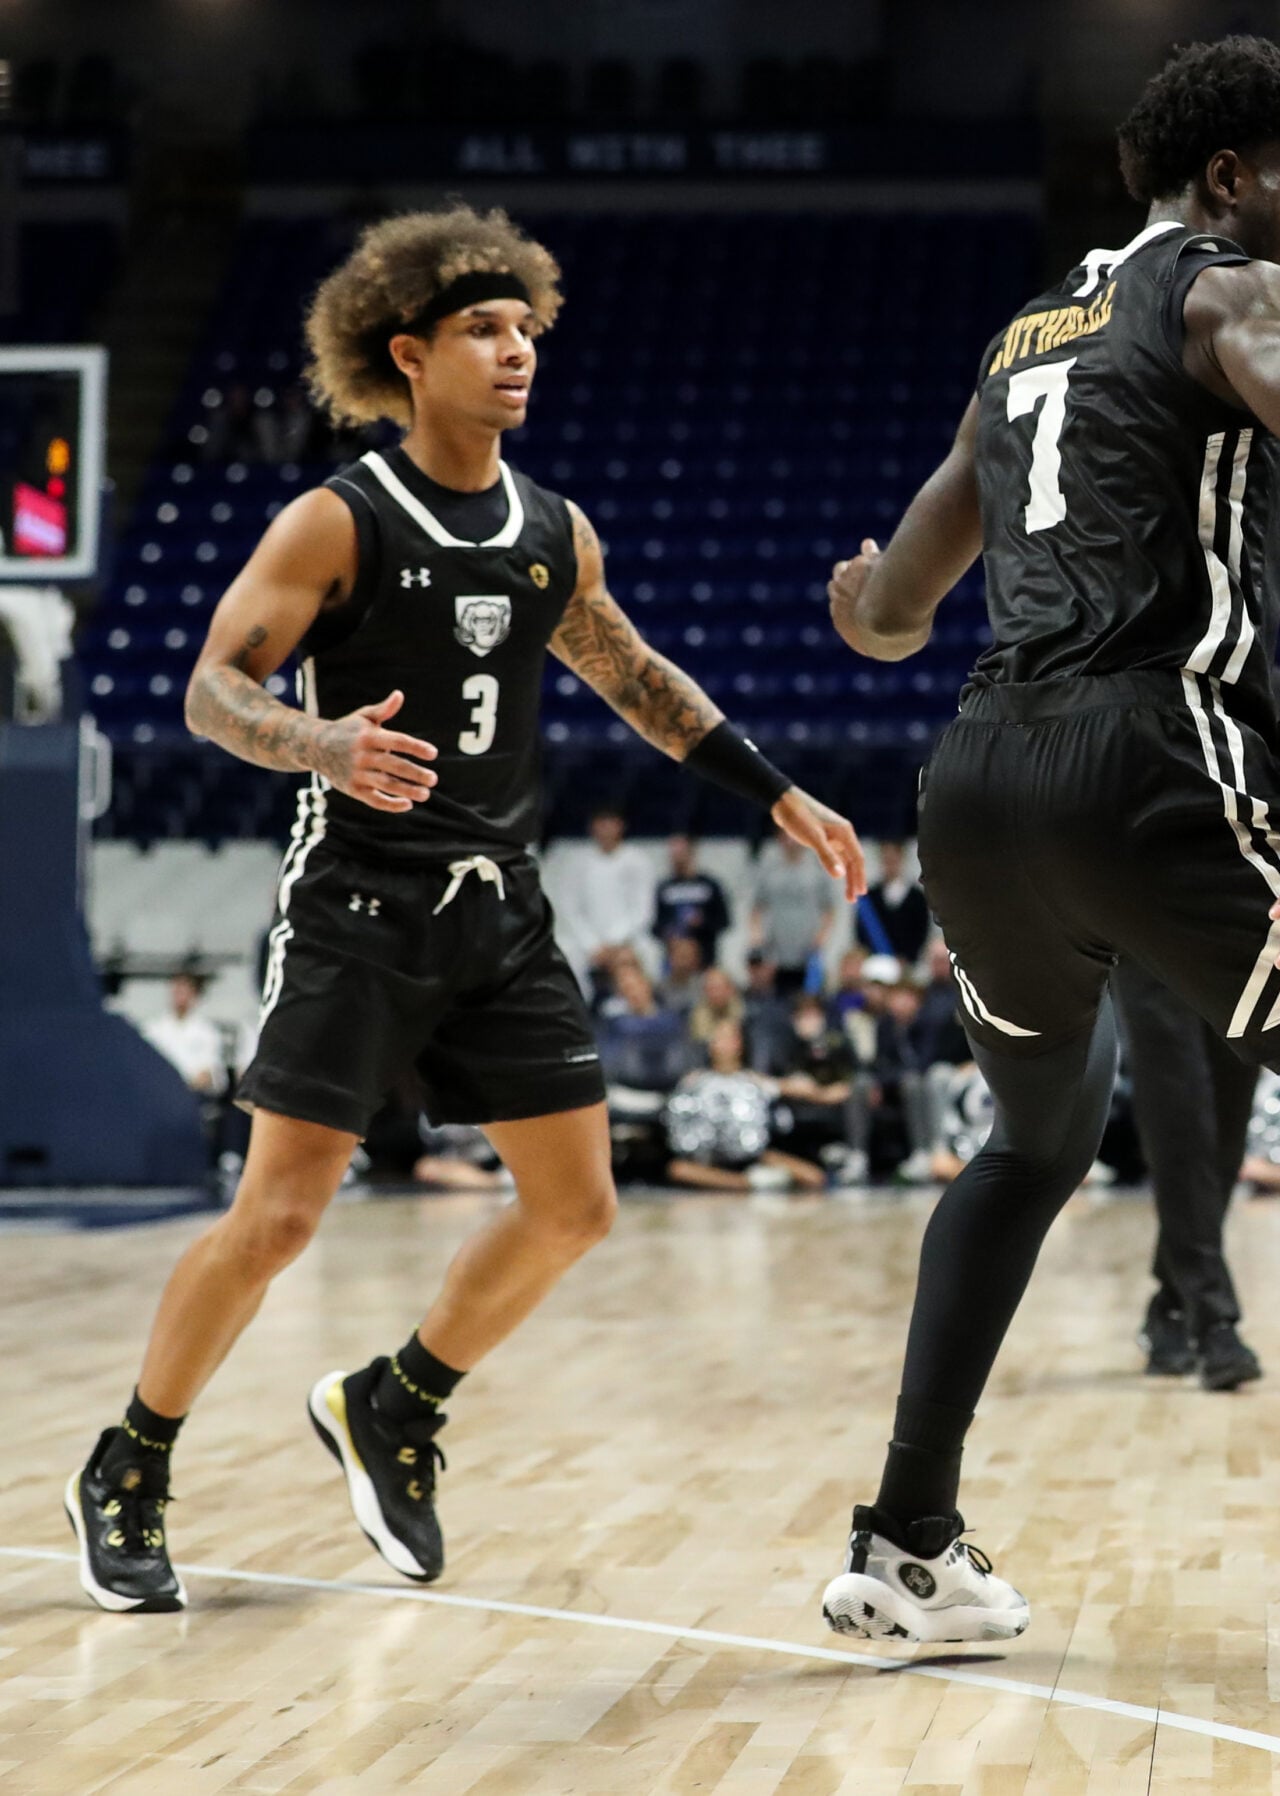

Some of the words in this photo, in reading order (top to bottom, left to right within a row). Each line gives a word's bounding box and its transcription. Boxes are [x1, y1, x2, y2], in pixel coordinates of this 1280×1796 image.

[459, 134, 543, 171] ALL
[568, 132, 687, 171] WITH
[711, 131, 823, 171] THEE
[1006, 356, 1078, 536] 7
[457, 673, 499, 755] 3
